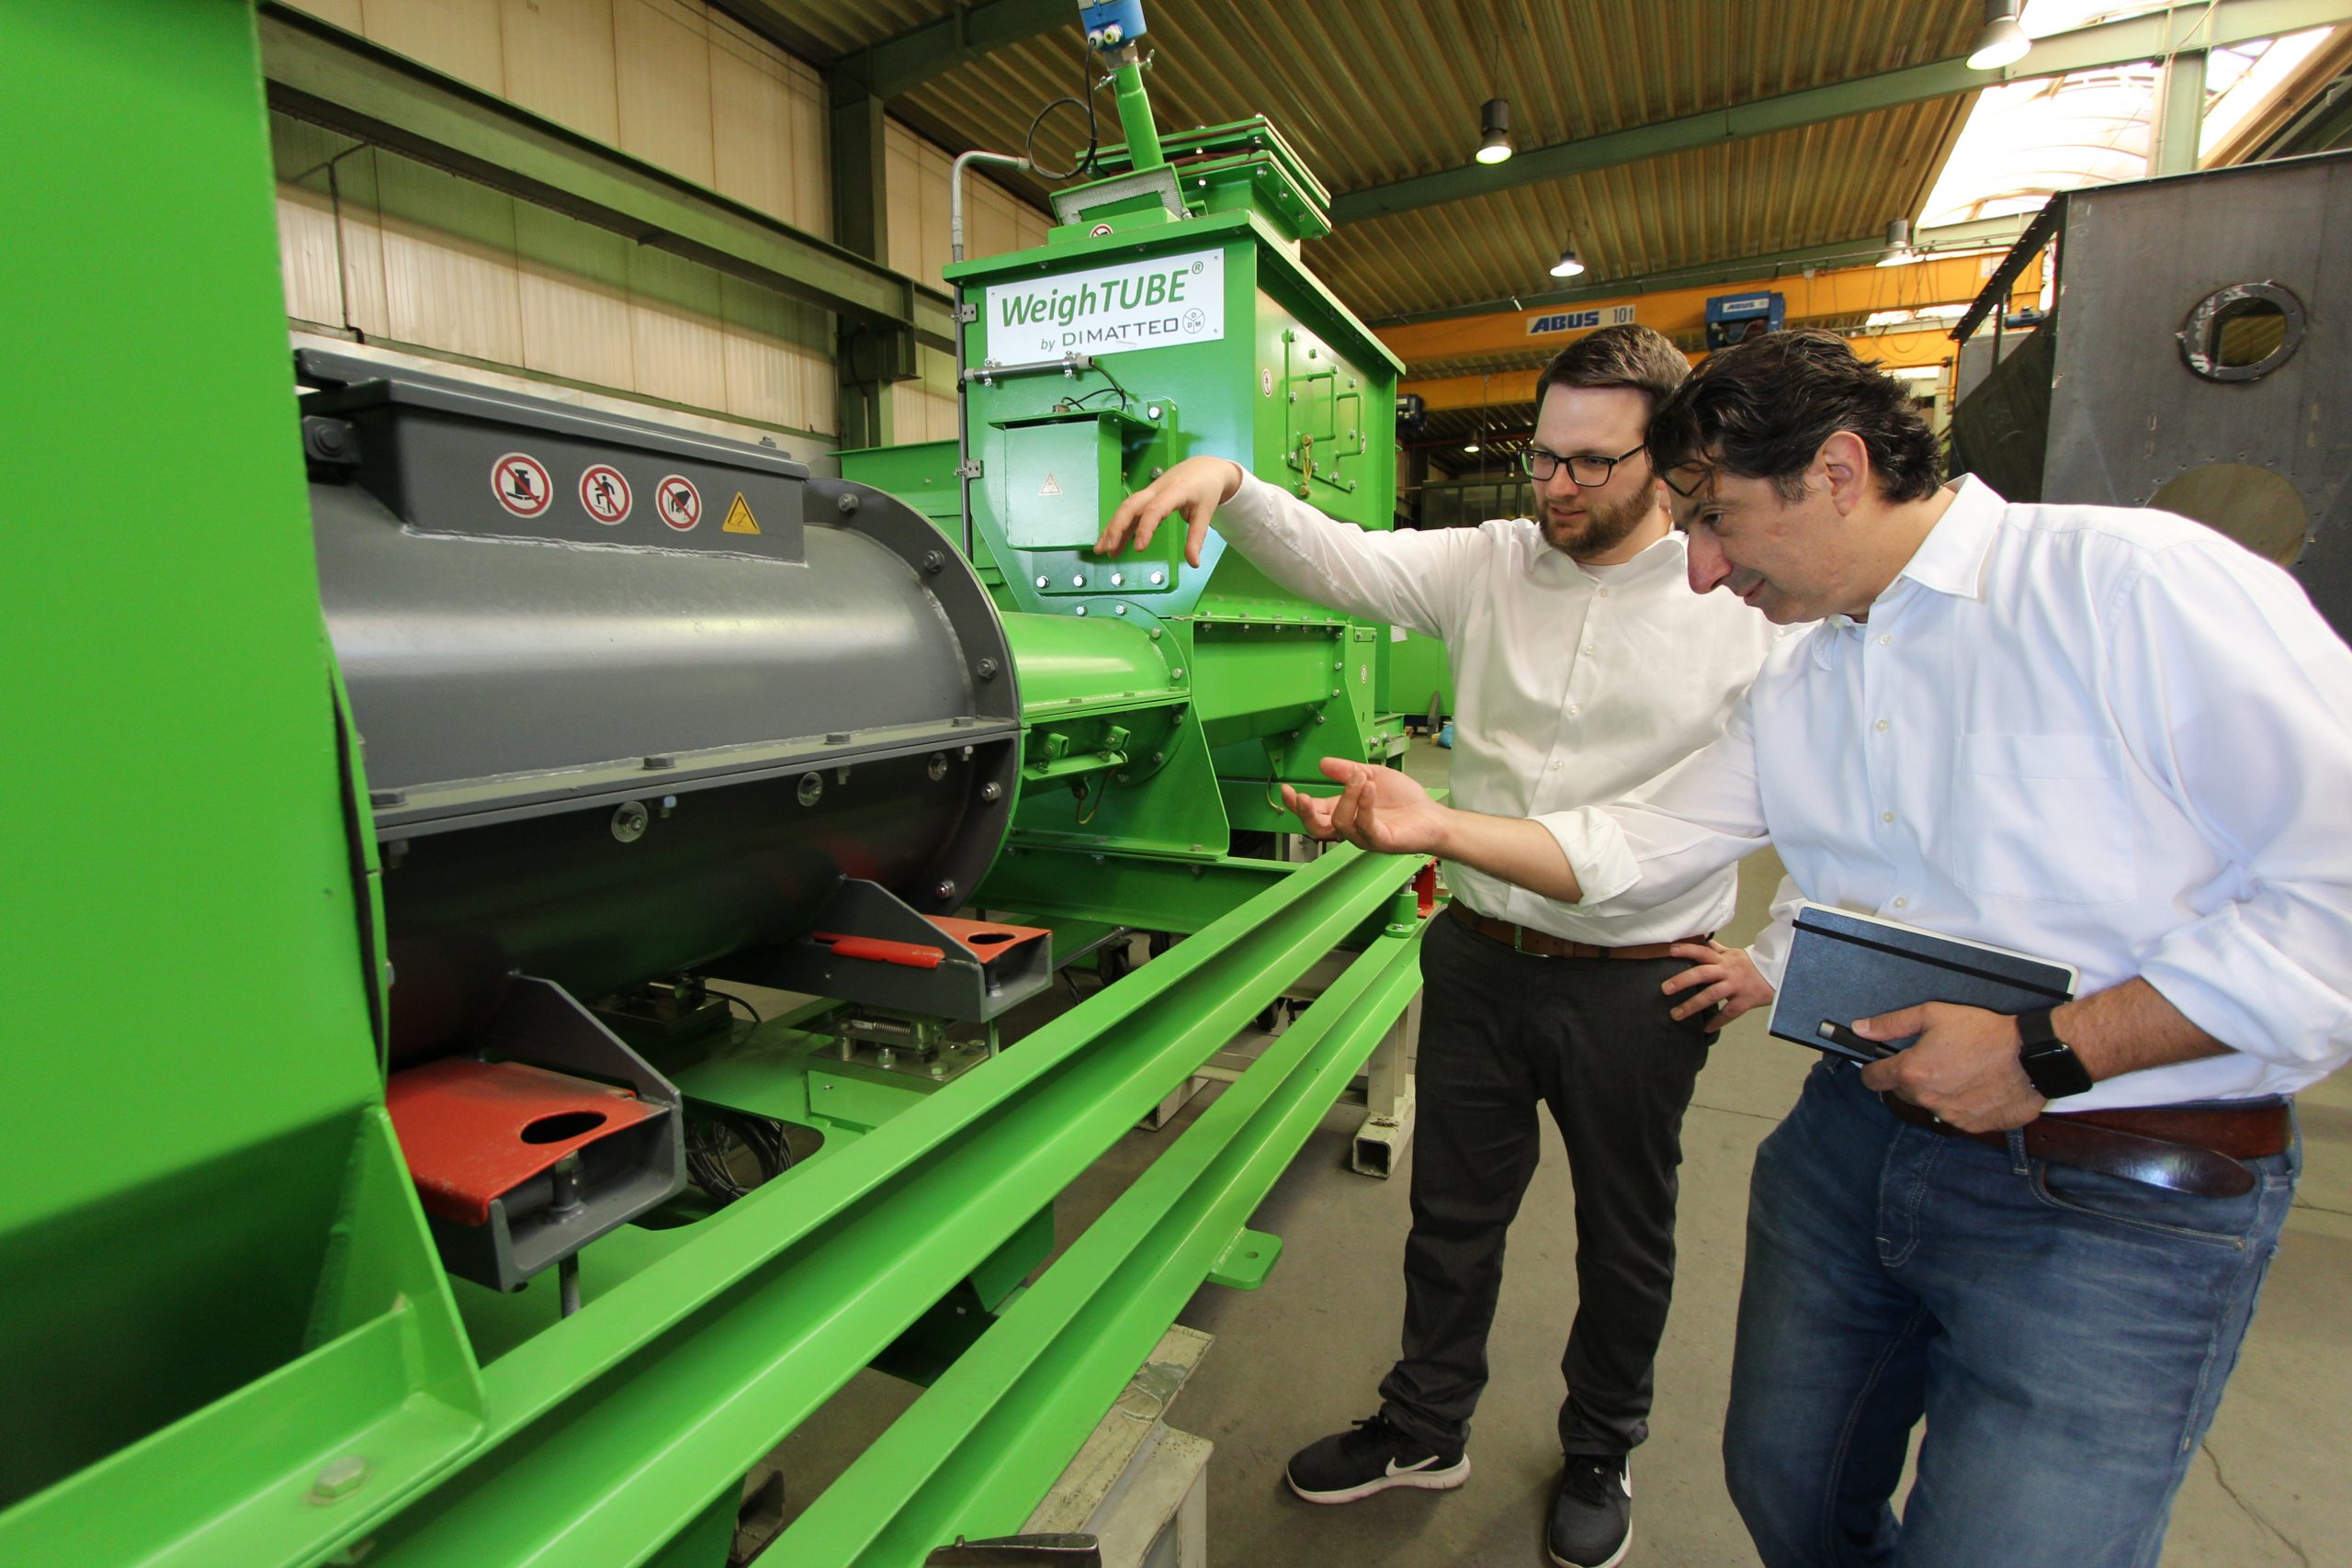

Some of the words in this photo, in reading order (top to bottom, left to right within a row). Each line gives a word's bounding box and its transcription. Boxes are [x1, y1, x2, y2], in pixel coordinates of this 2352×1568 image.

[1040, 337, 1056, 352] by
[1062, 317, 1179, 346] DIMATTEO
[1529, 310, 1600, 334] ABUS
